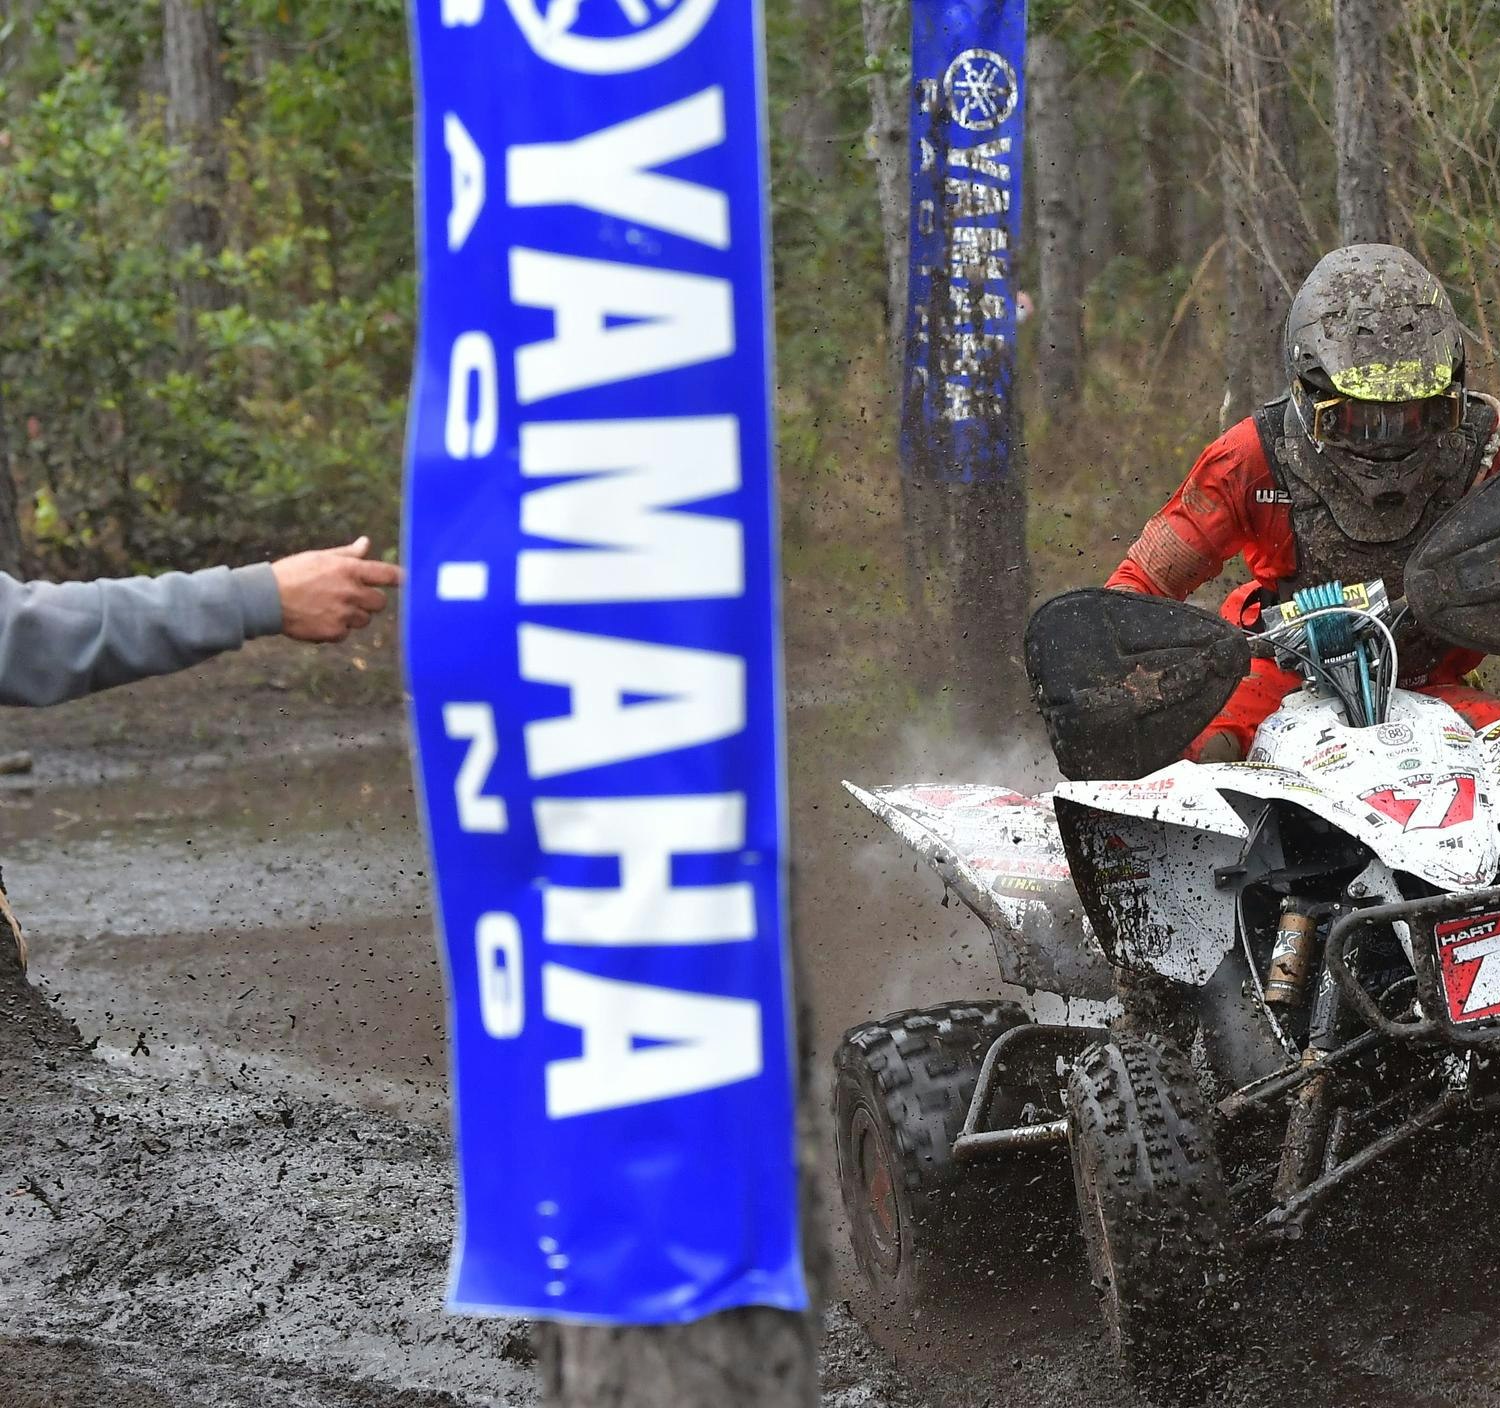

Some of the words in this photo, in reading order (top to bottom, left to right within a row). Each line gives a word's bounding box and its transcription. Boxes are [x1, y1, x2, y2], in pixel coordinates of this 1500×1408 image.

[437, 0, 525, 1039] ACING
[506, 84, 763, 1120] YAMAHA
[1387, 727, 1404, 739] 88
[1393, 774, 1460, 834] 7
[1441, 921, 1496, 946] HART
